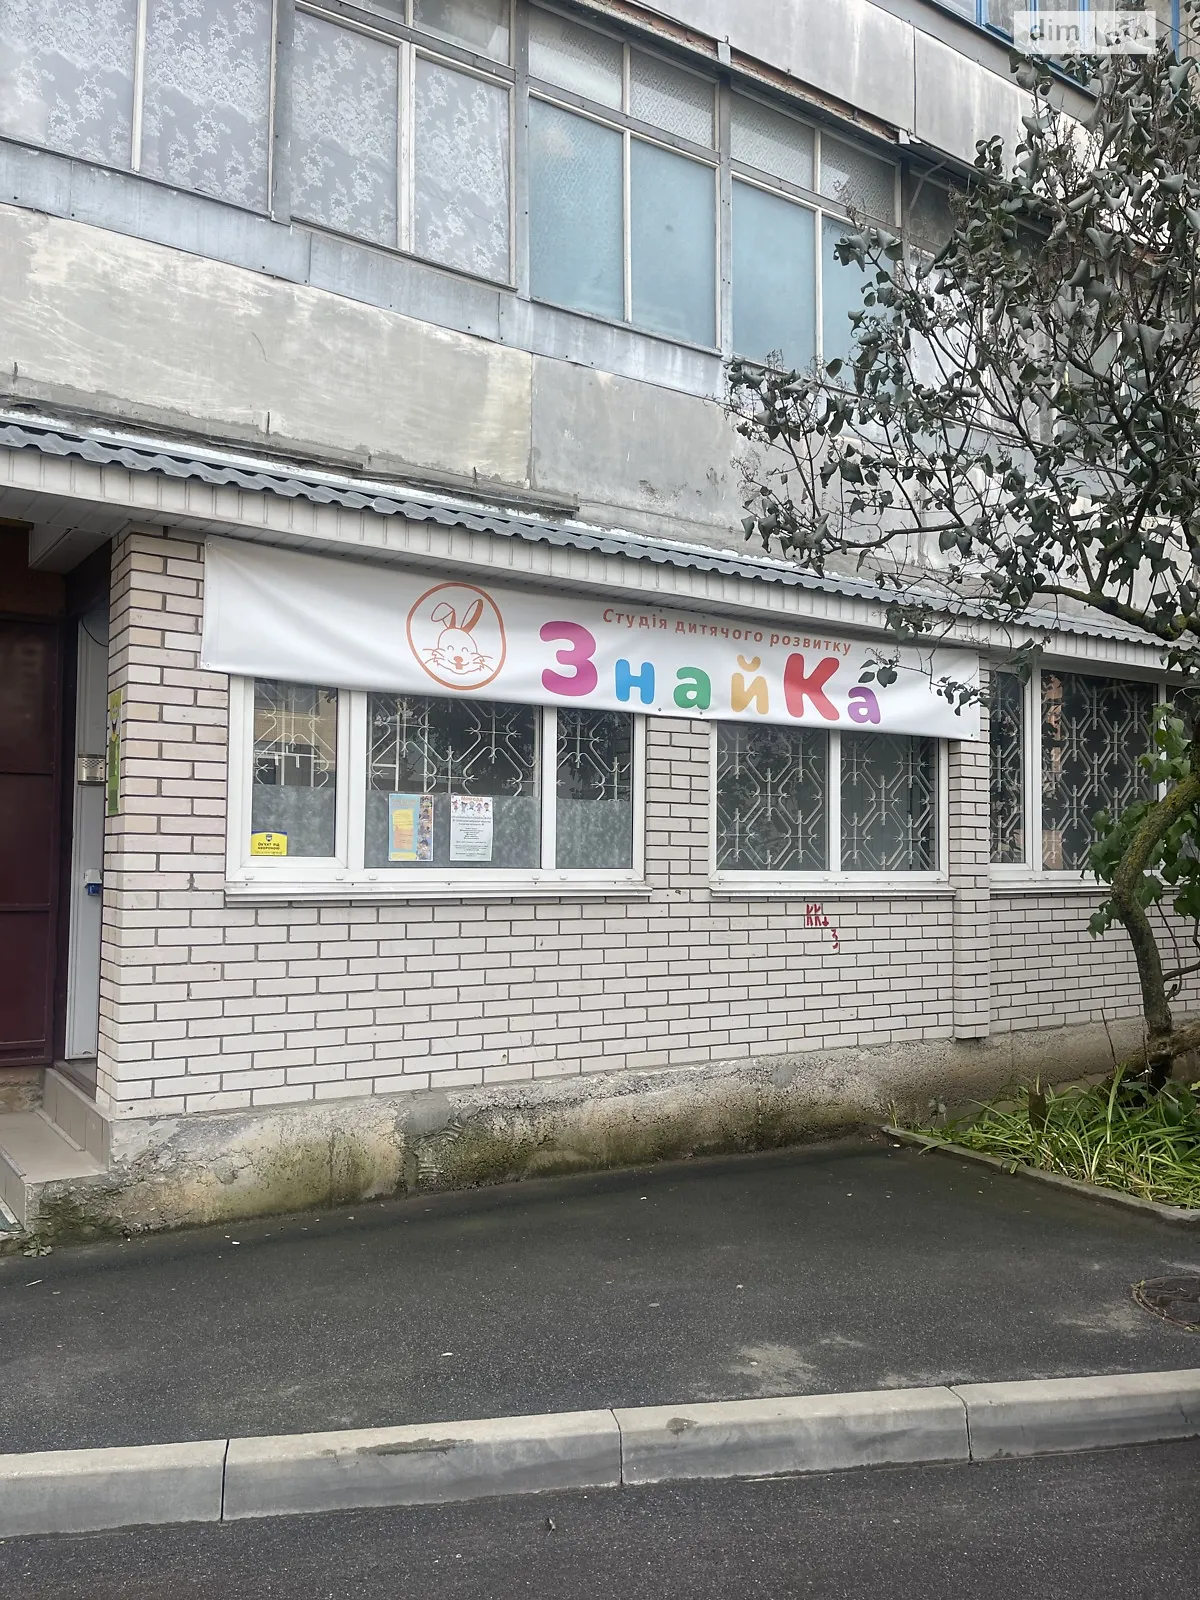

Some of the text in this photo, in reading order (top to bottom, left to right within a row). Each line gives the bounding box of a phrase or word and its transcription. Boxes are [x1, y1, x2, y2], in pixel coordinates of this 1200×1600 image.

[602, 608, 852, 656] Студія дитячого розвитку
